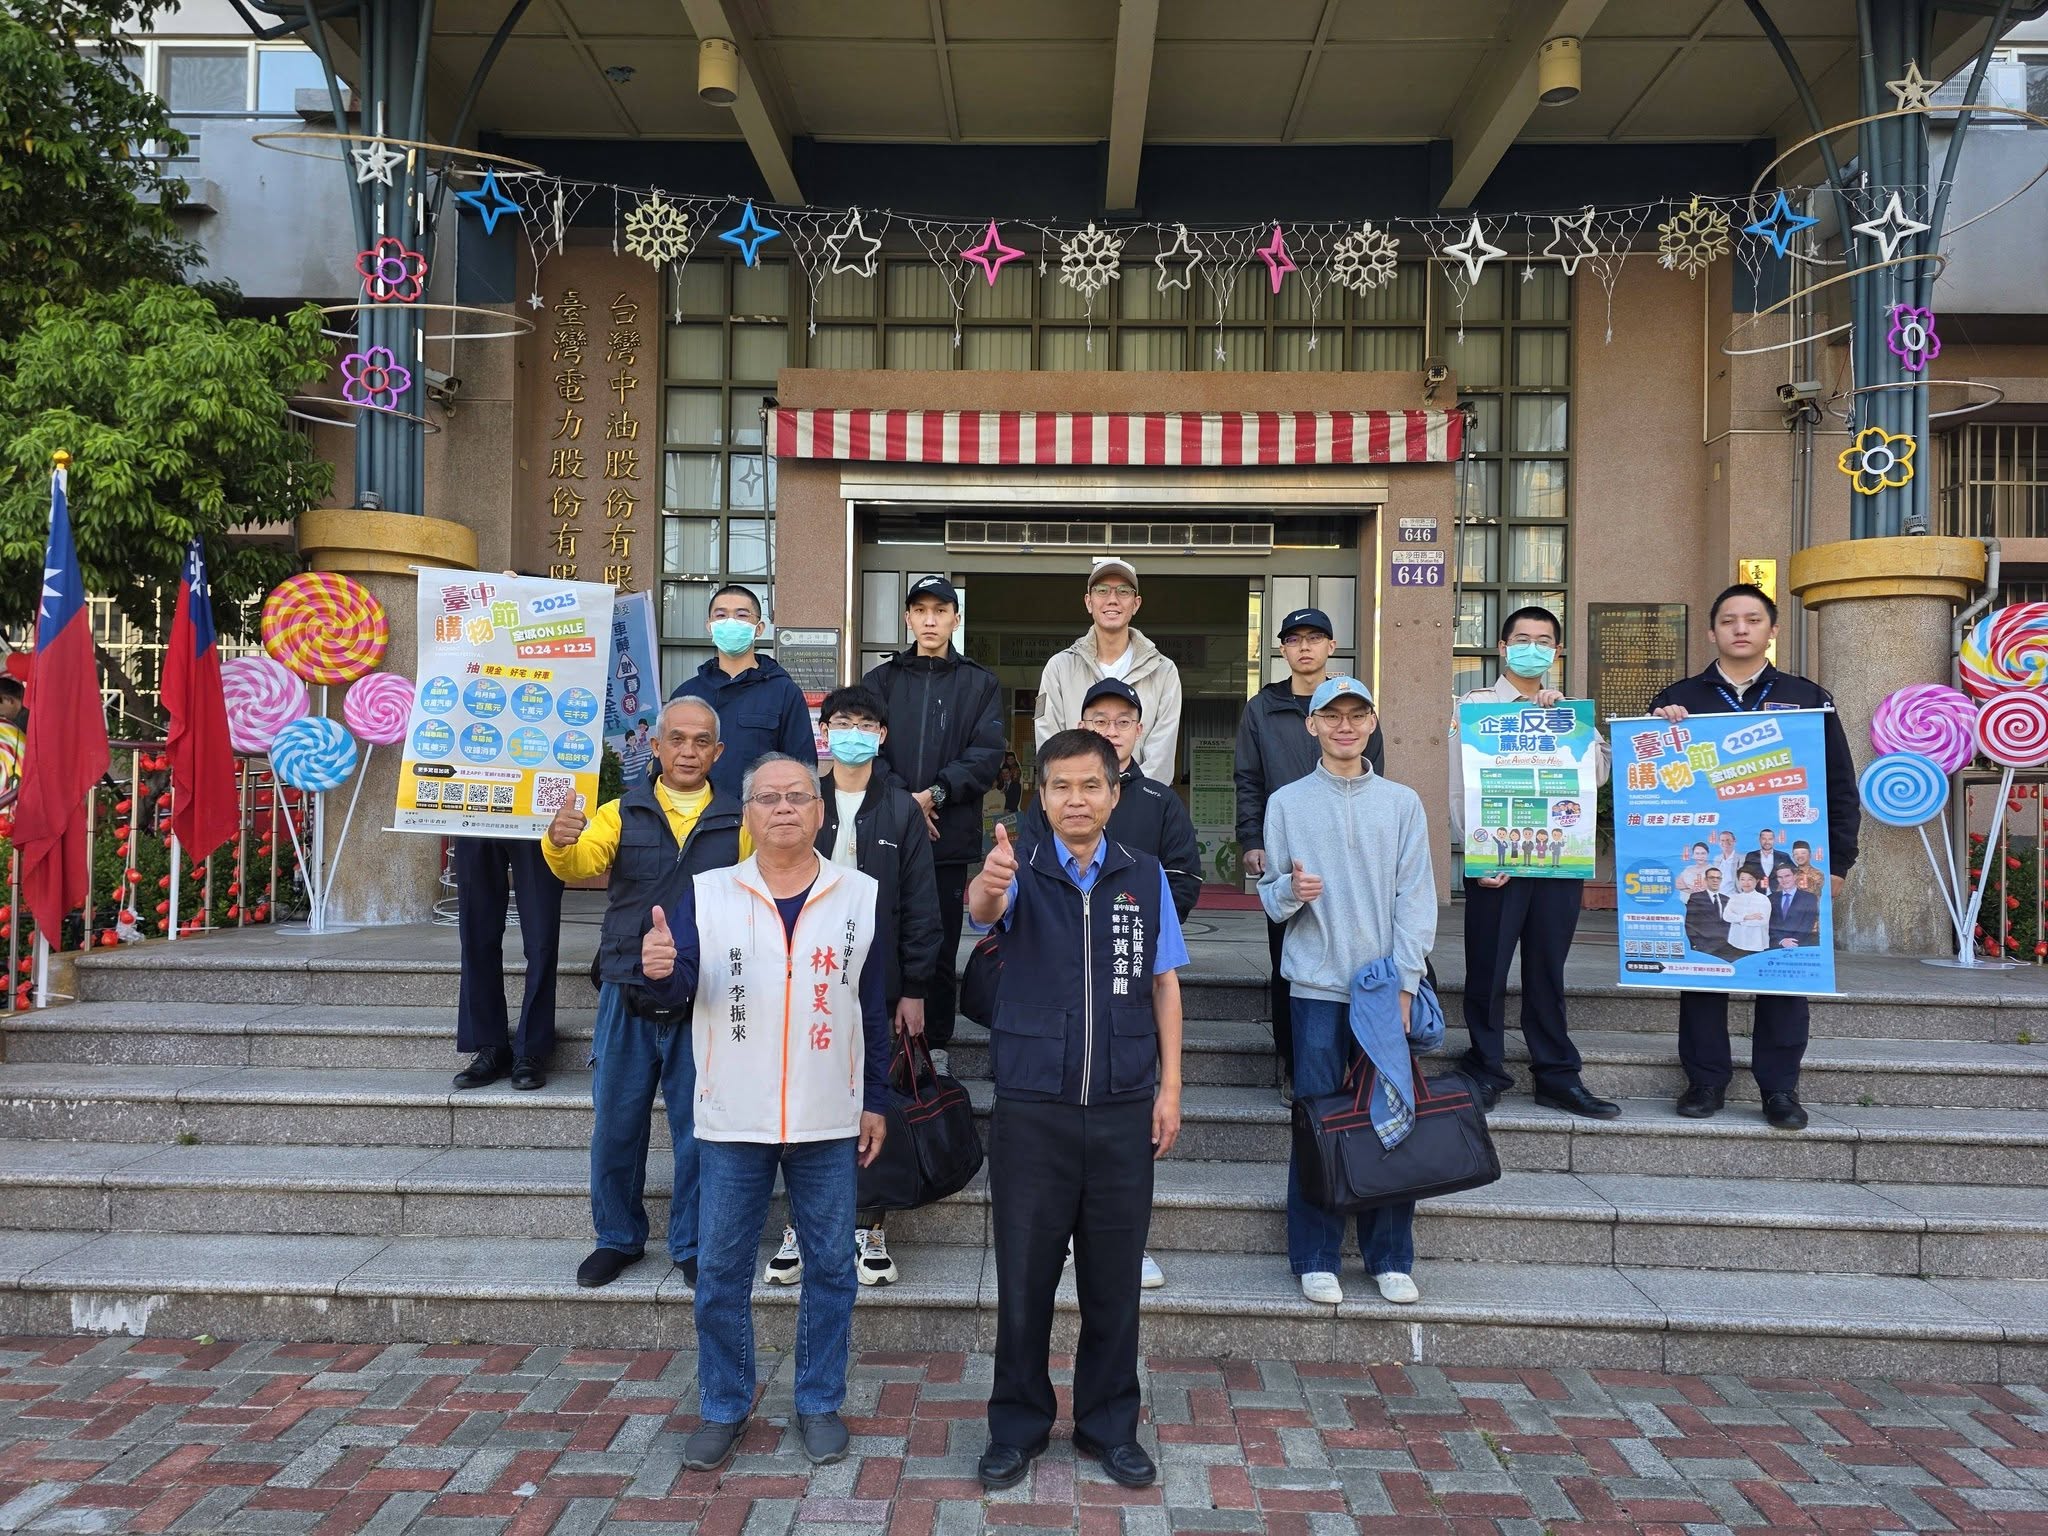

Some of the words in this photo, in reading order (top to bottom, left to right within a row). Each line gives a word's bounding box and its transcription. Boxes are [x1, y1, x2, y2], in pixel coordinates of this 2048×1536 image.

[1405, 528, 1431, 541] 646
[1397, 566, 1439, 584] 646
[440, 582, 496, 613] 臺中
[531, 593, 577, 614] 2025
[434, 601, 520, 645] 購物節
[556, 622, 583, 636] SALE
[519, 645, 551, 656] 10.24
[563, 643, 592, 653] 12.25
[466, 662, 480, 674] 抽
[486, 665, 502, 675] 現金
[510, 668, 527, 678] 好宅
[534, 671, 550, 680] 好車
[564, 710, 589, 719] 三千元
[1480, 709, 1575, 734] 企業反毒
[1500, 735, 1556, 751] 贏財富
[1633, 726, 1690, 760] 臺中
[1728, 723, 1777, 750] 2025
[511, 738, 523, 757] 5
[1628, 743, 1719, 791] 購物節
[1759, 753, 1791, 770] SALE
[1719, 783, 1755, 797] 10.24
[1768, 774, 1803, 788] 12.25
[1628, 814, 1641, 825] 抽
[1647, 815, 1665, 824] 現金
[1672, 815, 1690, 824] 好宅
[1698, 815, 1716, 824] 好車
[1625, 873, 1640, 894] 5
[1121, 915, 1129, 933] 主任
[1132, 916, 1144, 978] 大肚區公所
[729, 947, 742, 976] 秘書
[1112, 938, 1128, 995] 黃金龍
[808, 946, 839, 1050] 林昊佑
[728, 985, 746, 1042] 李振來
